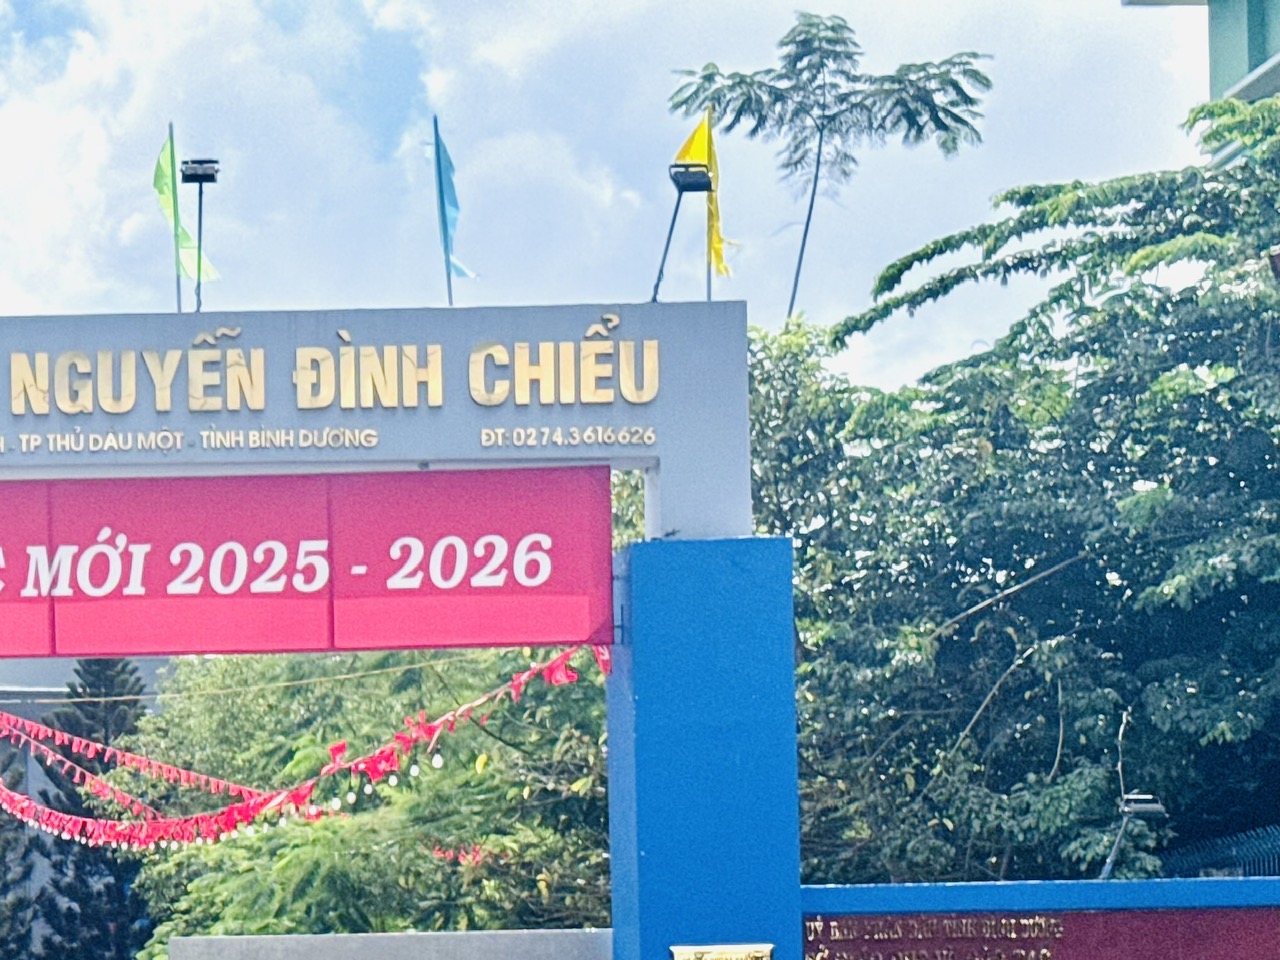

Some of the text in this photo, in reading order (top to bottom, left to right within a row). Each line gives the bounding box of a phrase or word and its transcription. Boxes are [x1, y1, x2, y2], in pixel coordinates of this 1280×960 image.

[10, 326, 266, 416] NGUYỄN
[293, 329, 443, 409] ĐÌNH
[468, 314, 660, 407] CHIỂU
[19, 433, 42, 453] TP
[46, 425, 85, 452] THỦ
[137, 425, 184, 455] MỘT
[248, 424, 294, 449] BÌNH
[298, 427, 378, 448] DƯƠNG
[20, 527, 151, 599] MỚI
[166, 539, 330, 595] 2025
[385, 533, 553, 590] 2026
